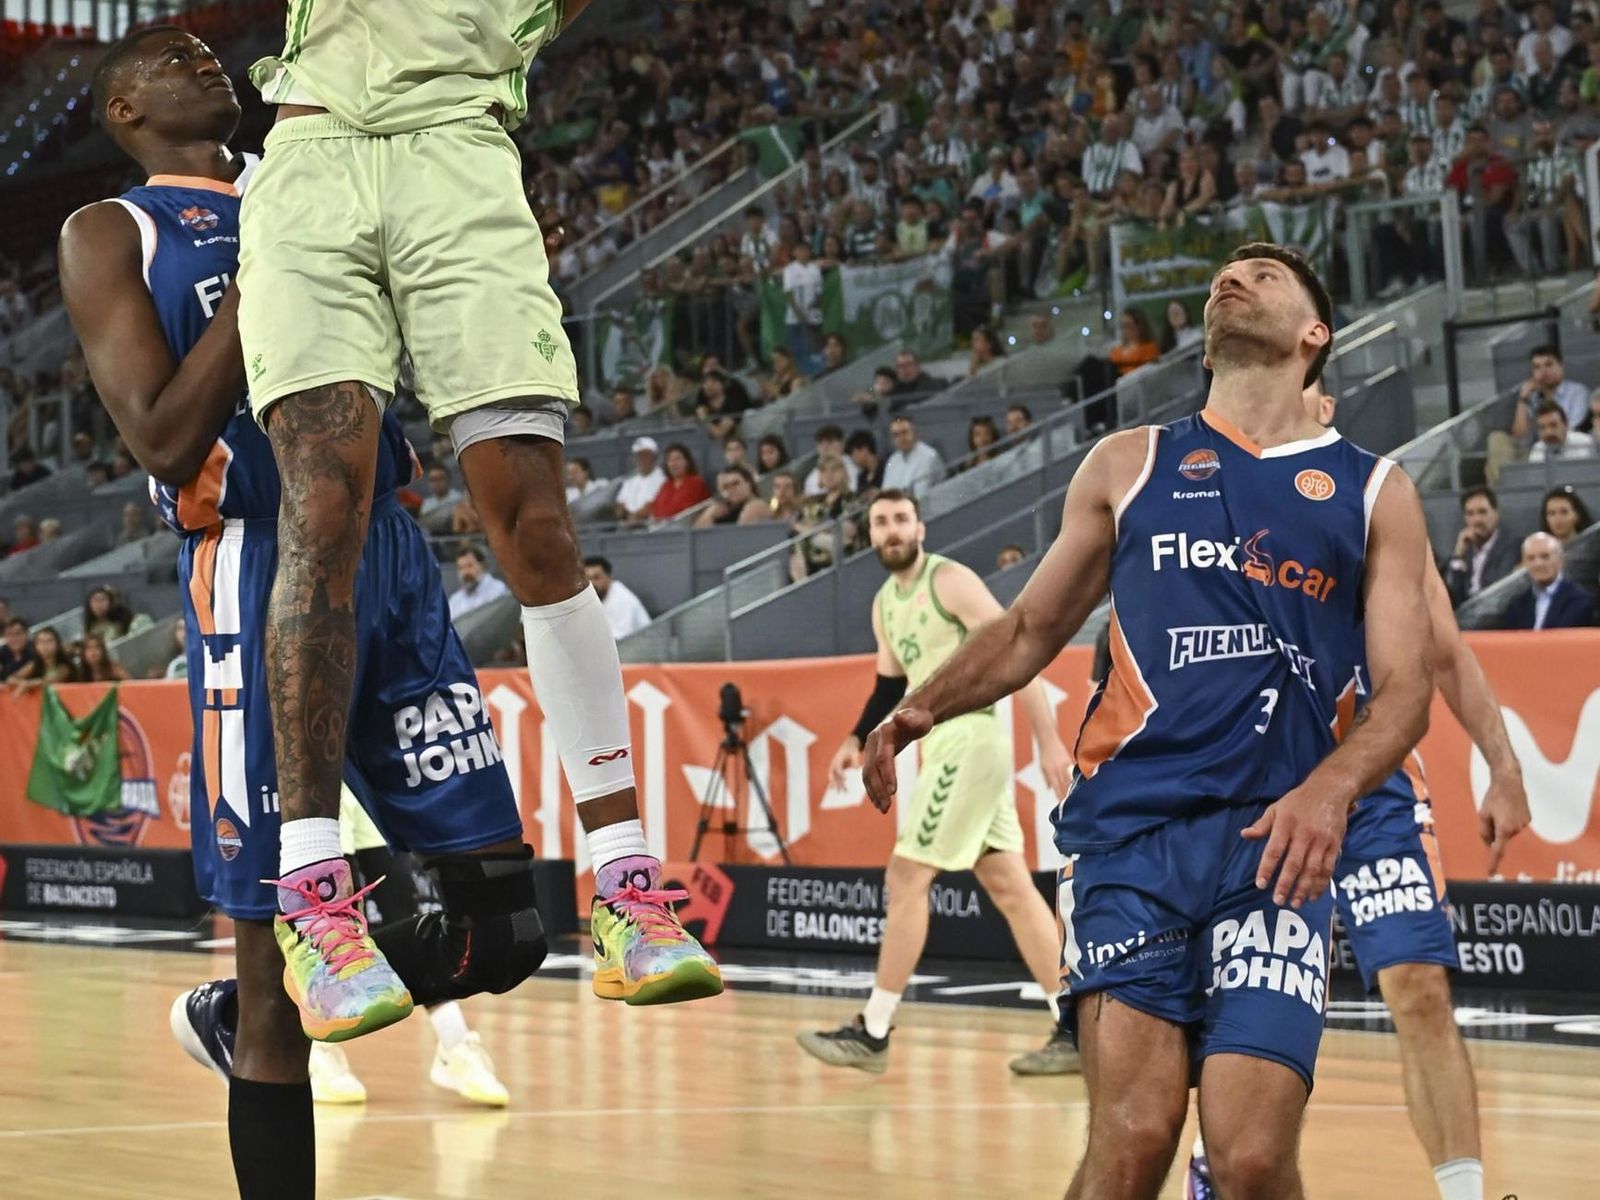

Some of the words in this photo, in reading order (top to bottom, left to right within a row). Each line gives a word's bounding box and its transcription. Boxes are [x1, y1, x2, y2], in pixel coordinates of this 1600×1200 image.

[1254, 688, 1280, 735] 3
[767, 877, 878, 909] FEDERACIÓN
[1339, 857, 1429, 900] PAPA
[767, 910, 789, 938] DE
[1351, 885, 1434, 927] JOHNS
[1212, 910, 1325, 976] PAPA
[1206, 956, 1326, 1015] JOHNS
